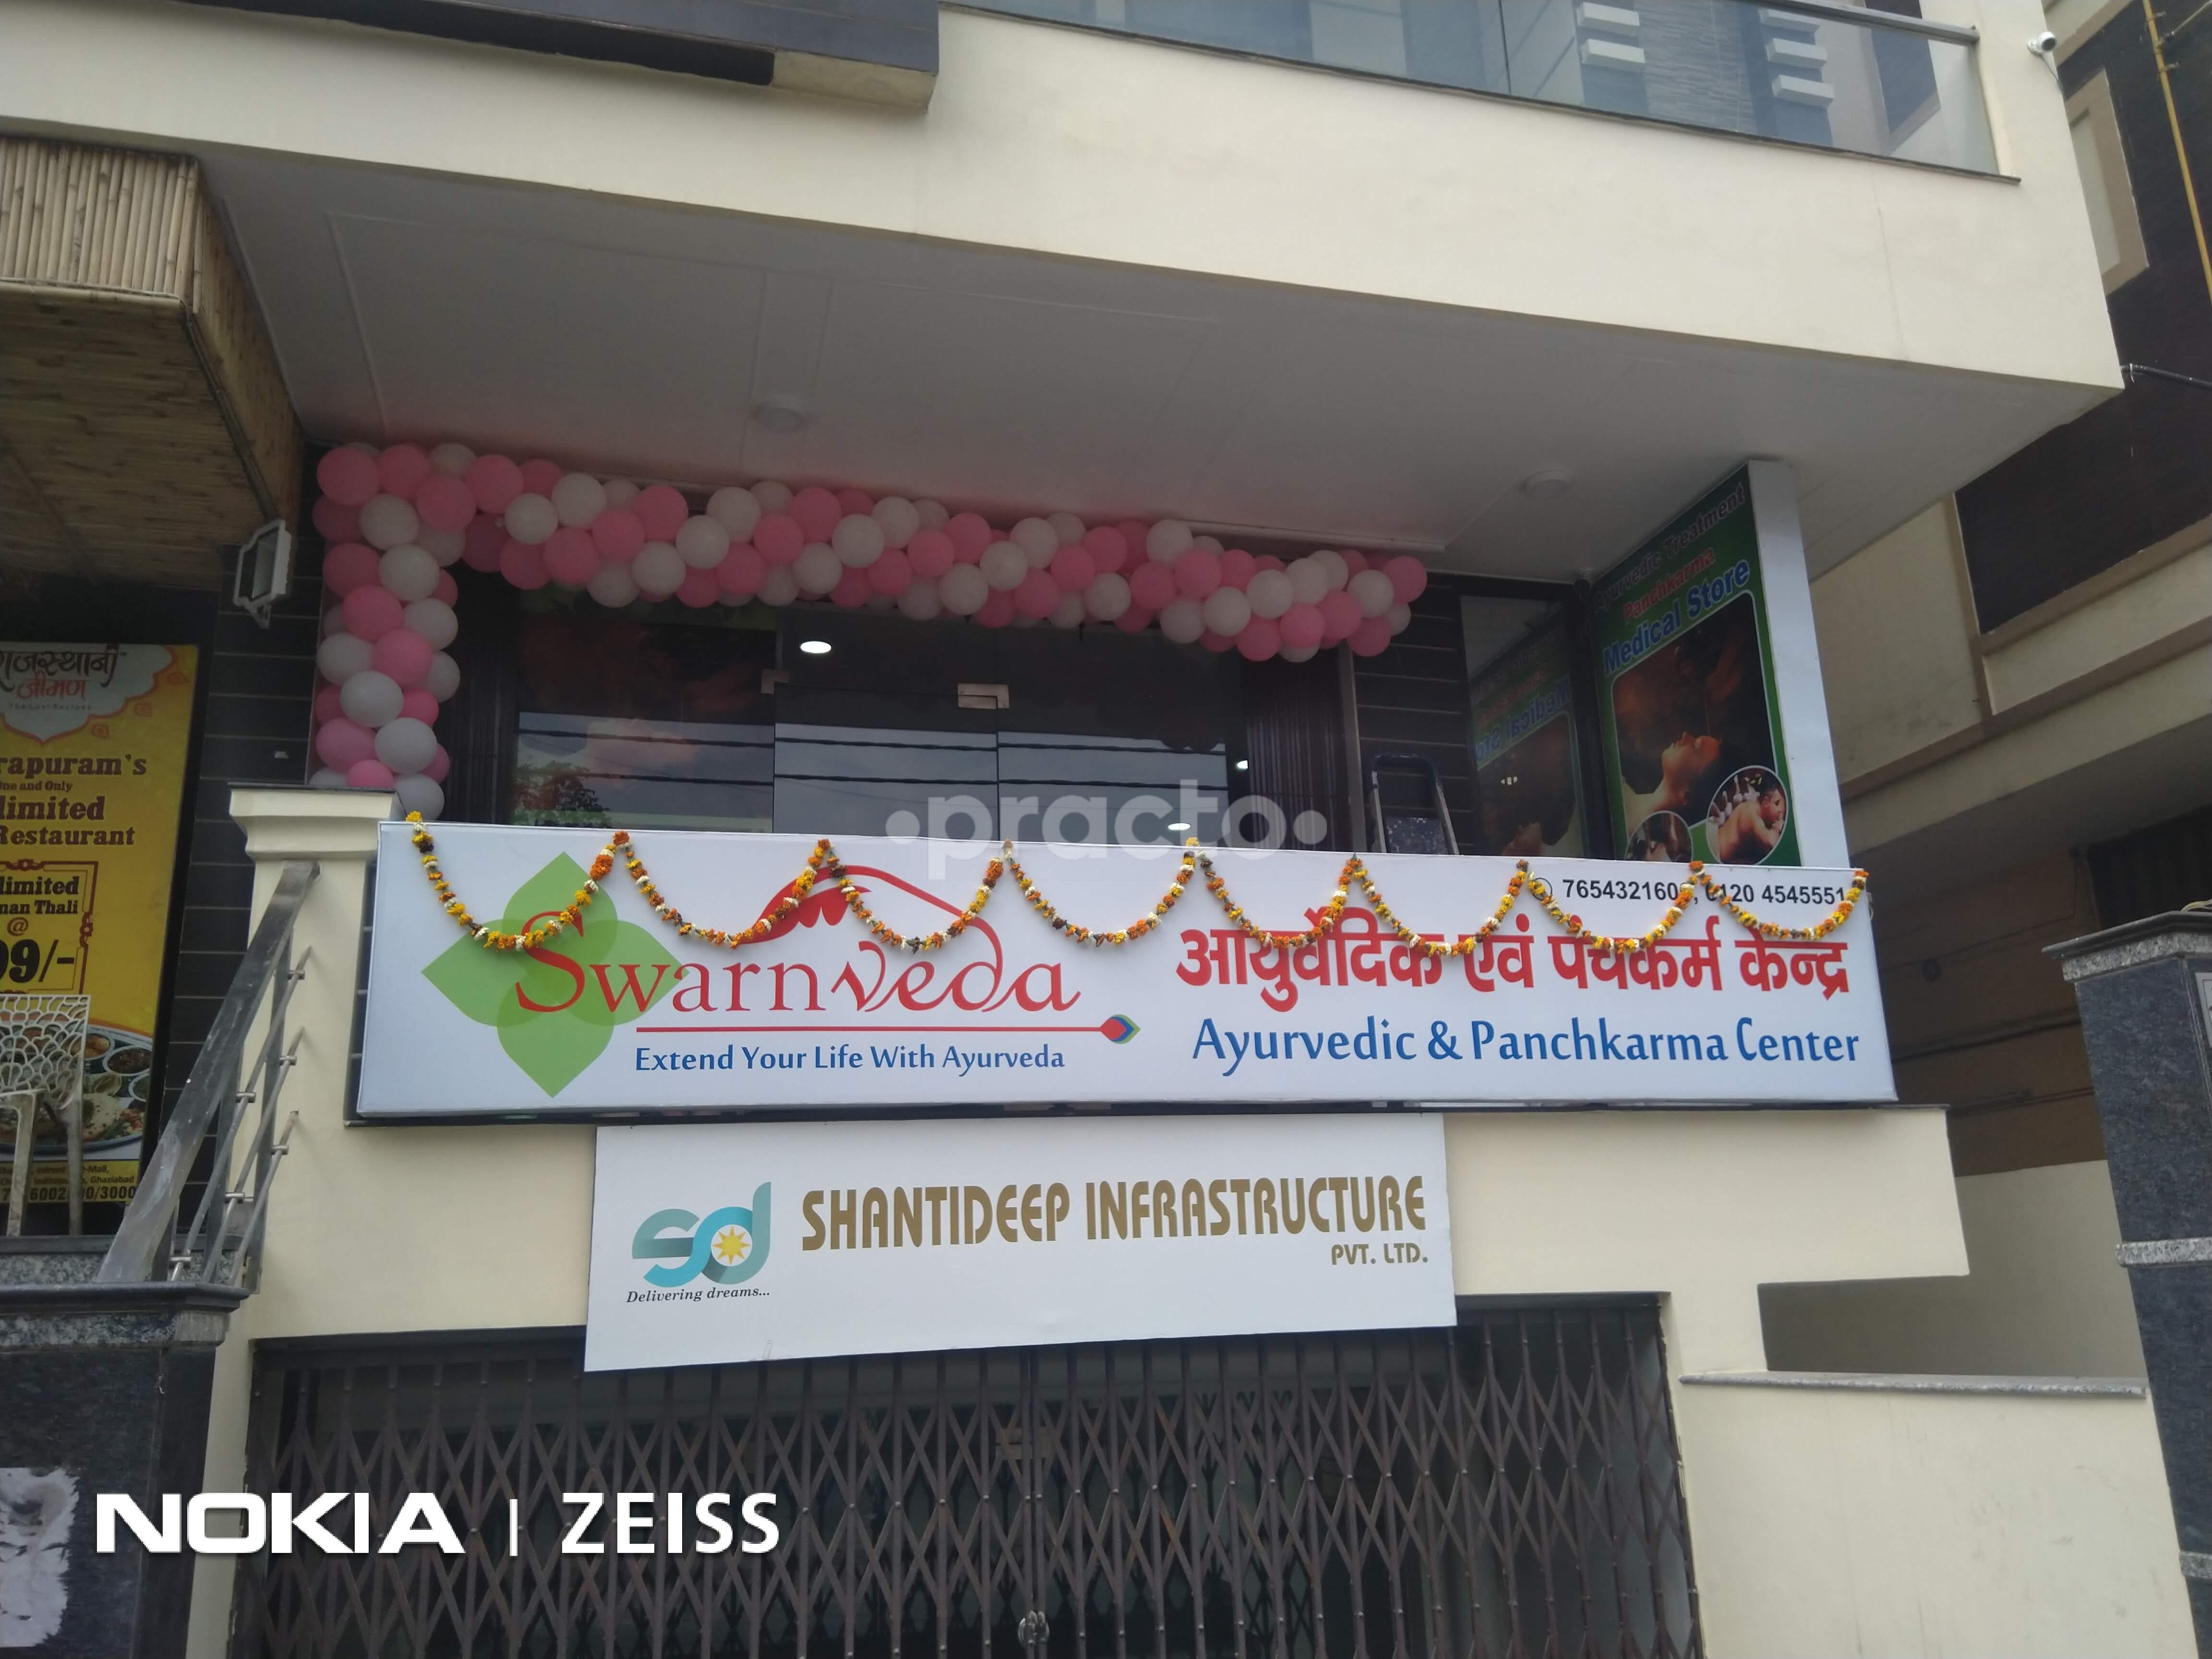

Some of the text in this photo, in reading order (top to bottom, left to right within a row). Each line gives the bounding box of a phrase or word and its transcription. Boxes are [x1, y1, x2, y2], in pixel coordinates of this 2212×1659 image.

[1664, 482, 1745, 558] Treatment
[1623, 547, 1716, 622] Panchkarma
[1603, 599, 1682, 676] Medical
[1687, 560, 1750, 617] Store
[19, 781, 42, 791] and
[45, 781, 72, 792] Only
[35, 900, 78, 914] Thali
[1762, 885, 1845, 905] 4545551
[7, 917, 28, 936] @
[1458, 913, 1535, 992] एवं
[636, 1044, 1065, 1077] Extend Your Life With Ayurveda
[1192, 1015, 1859, 1076] Ayurvedic & Panchkarma Center
[803, 1175, 1426, 1251] SHANTIDEEP INFRASTRUCTURE
[1331, 1242, 1429, 1265] PVT. LTD.
[626, 1287, 770, 1302] Delivering dreams...
